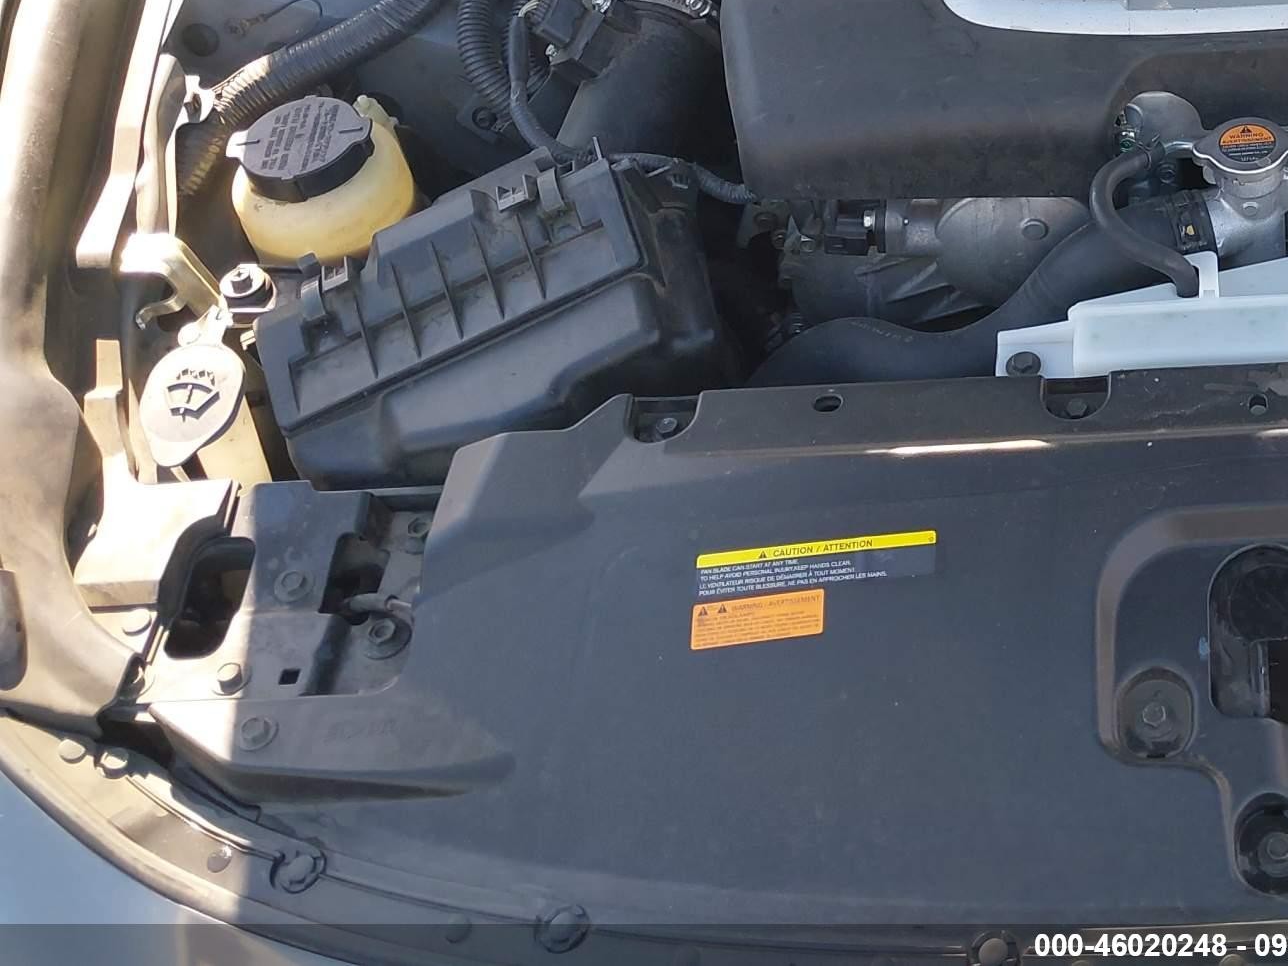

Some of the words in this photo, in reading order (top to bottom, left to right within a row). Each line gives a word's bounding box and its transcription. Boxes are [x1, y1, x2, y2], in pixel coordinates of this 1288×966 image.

[773, 546, 813, 557] CAUTION
[823, 540, 873, 552] ATTENTION
[709, 573, 724, 581] HELP
[724, 571, 742, 579] AVOID
[743, 569, 774, 577] PERSONAL
[809, 561, 830, 569] HANDS
[744, 563, 763, 571] START
[699, 588, 715, 596] POUR
[818, 574, 855, 583] APPROCHER
[708, 579, 743, 588] VENTILATEUR
[744, 576, 766, 584] RISQUE
[814, 568, 828, 576] TOUT
